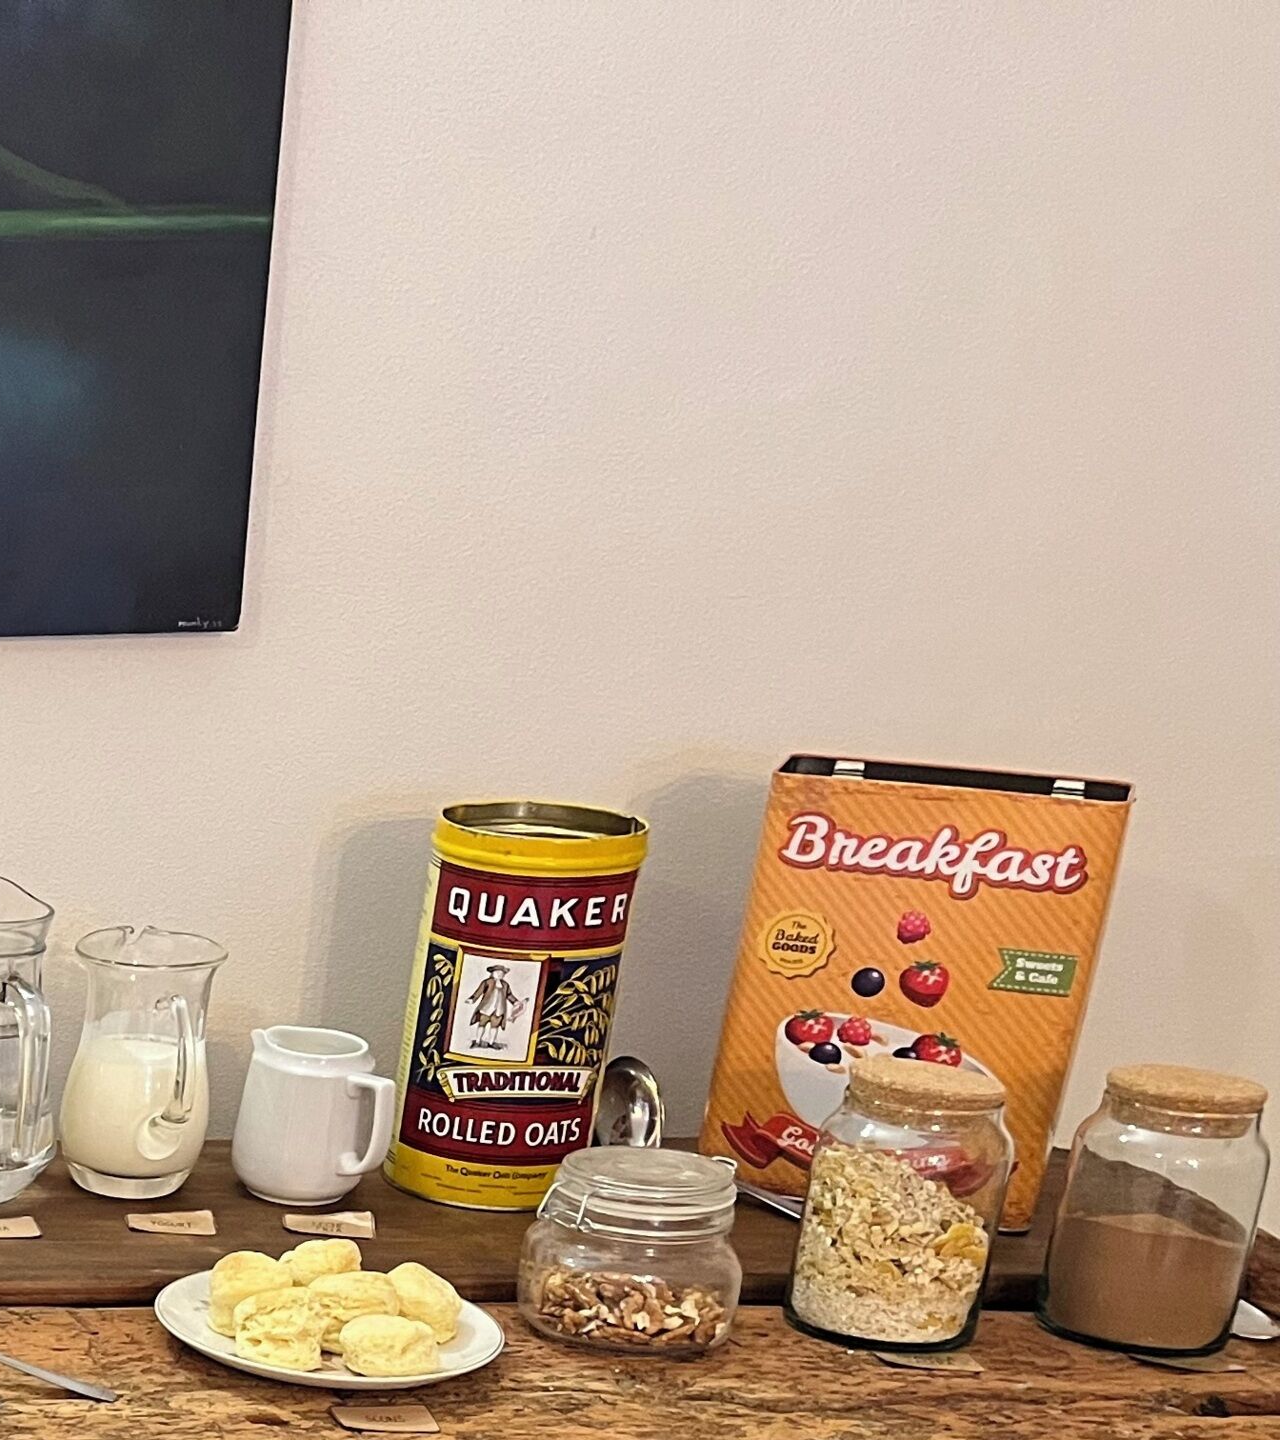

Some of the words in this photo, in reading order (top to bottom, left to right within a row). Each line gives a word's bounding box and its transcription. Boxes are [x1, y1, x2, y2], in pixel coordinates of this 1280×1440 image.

[780, 813, 1081, 895] Breakfast
[447, 886, 628, 928] QUAKER
[774, 928, 820, 945] Baked
[771, 941, 817, 955] GOODS
[1014, 970, 1026, 981] &
[452, 1071, 581, 1093] TRADITIONAL
[417, 1107, 517, 1146] ROLLED
[523, 1117, 582, 1147] OATS
